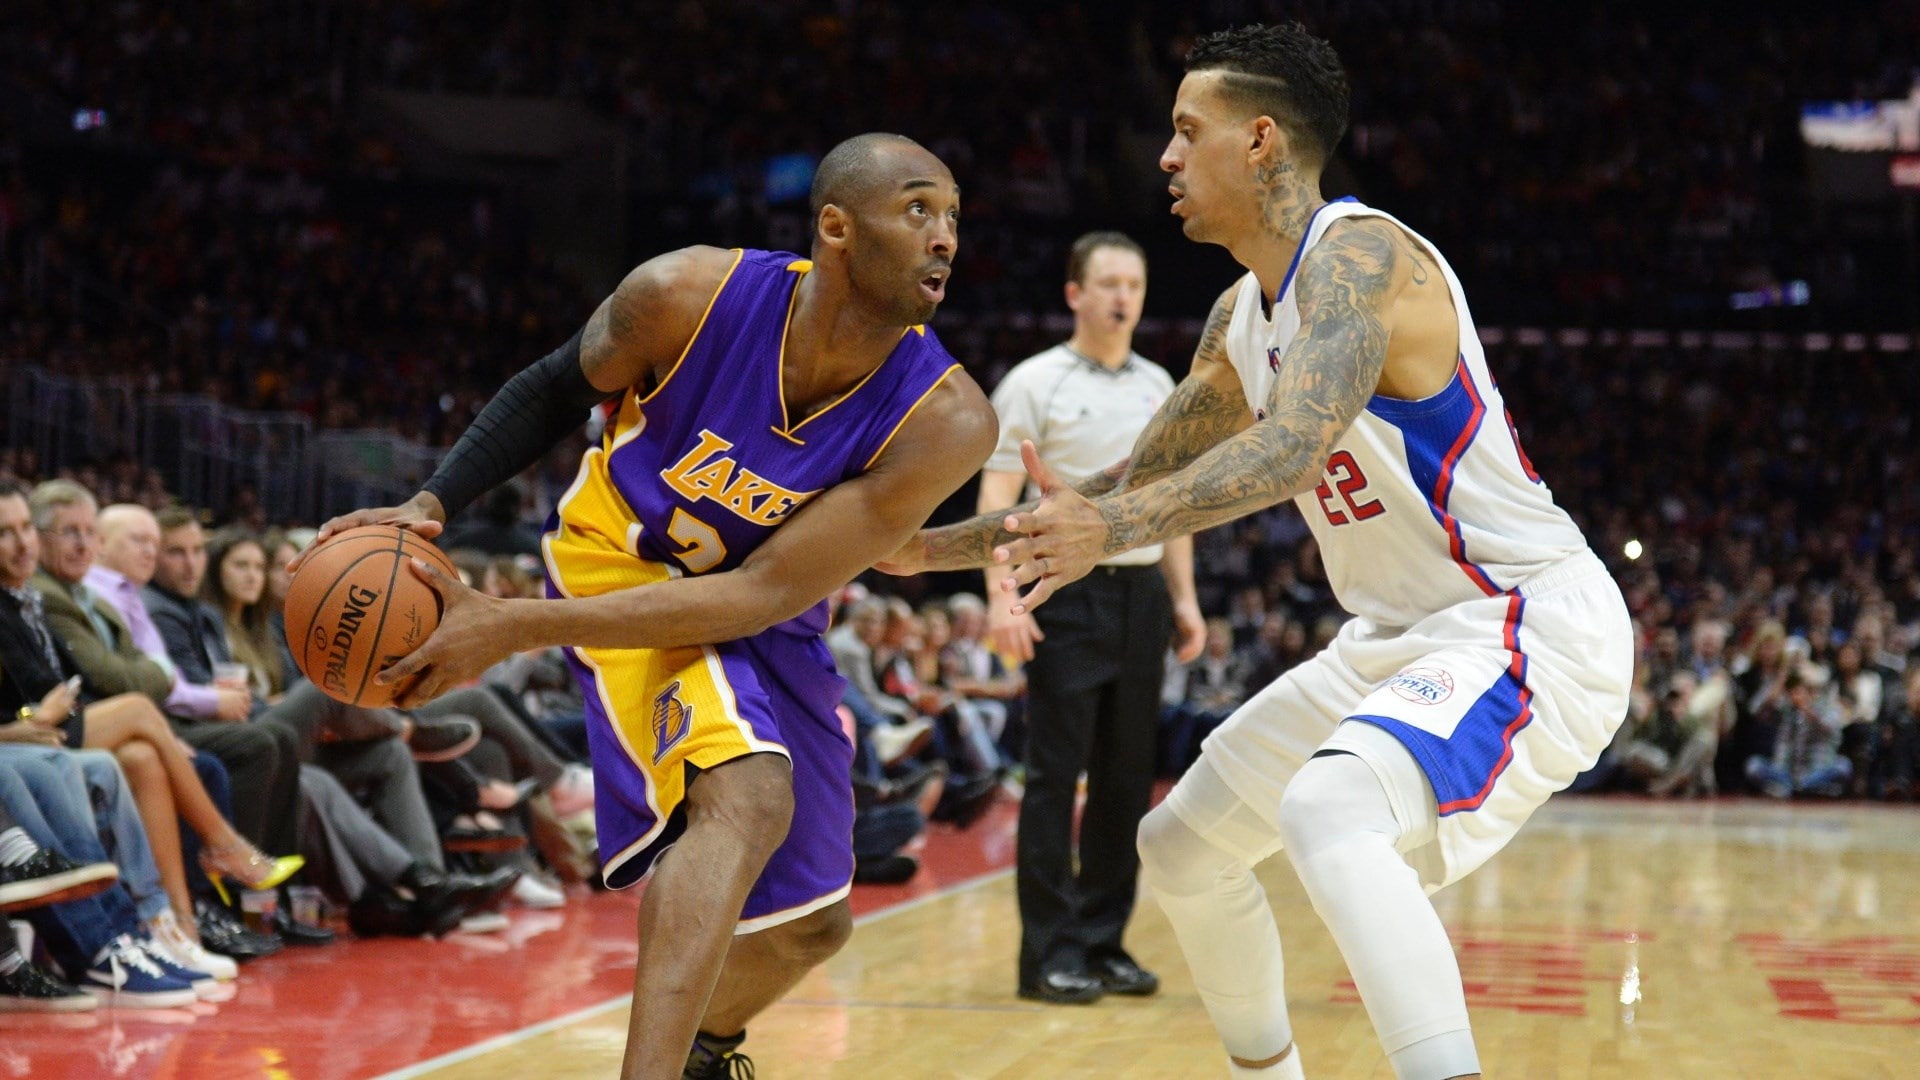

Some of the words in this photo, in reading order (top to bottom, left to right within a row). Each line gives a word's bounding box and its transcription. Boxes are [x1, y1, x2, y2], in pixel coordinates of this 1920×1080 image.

[659, 428, 826, 527] LAKE
[1314, 450, 1386, 527] 22
[667, 507, 728, 574] 2
[323, 584, 379, 697] SPALDING
[1382, 674, 1441, 701] IPPERS
